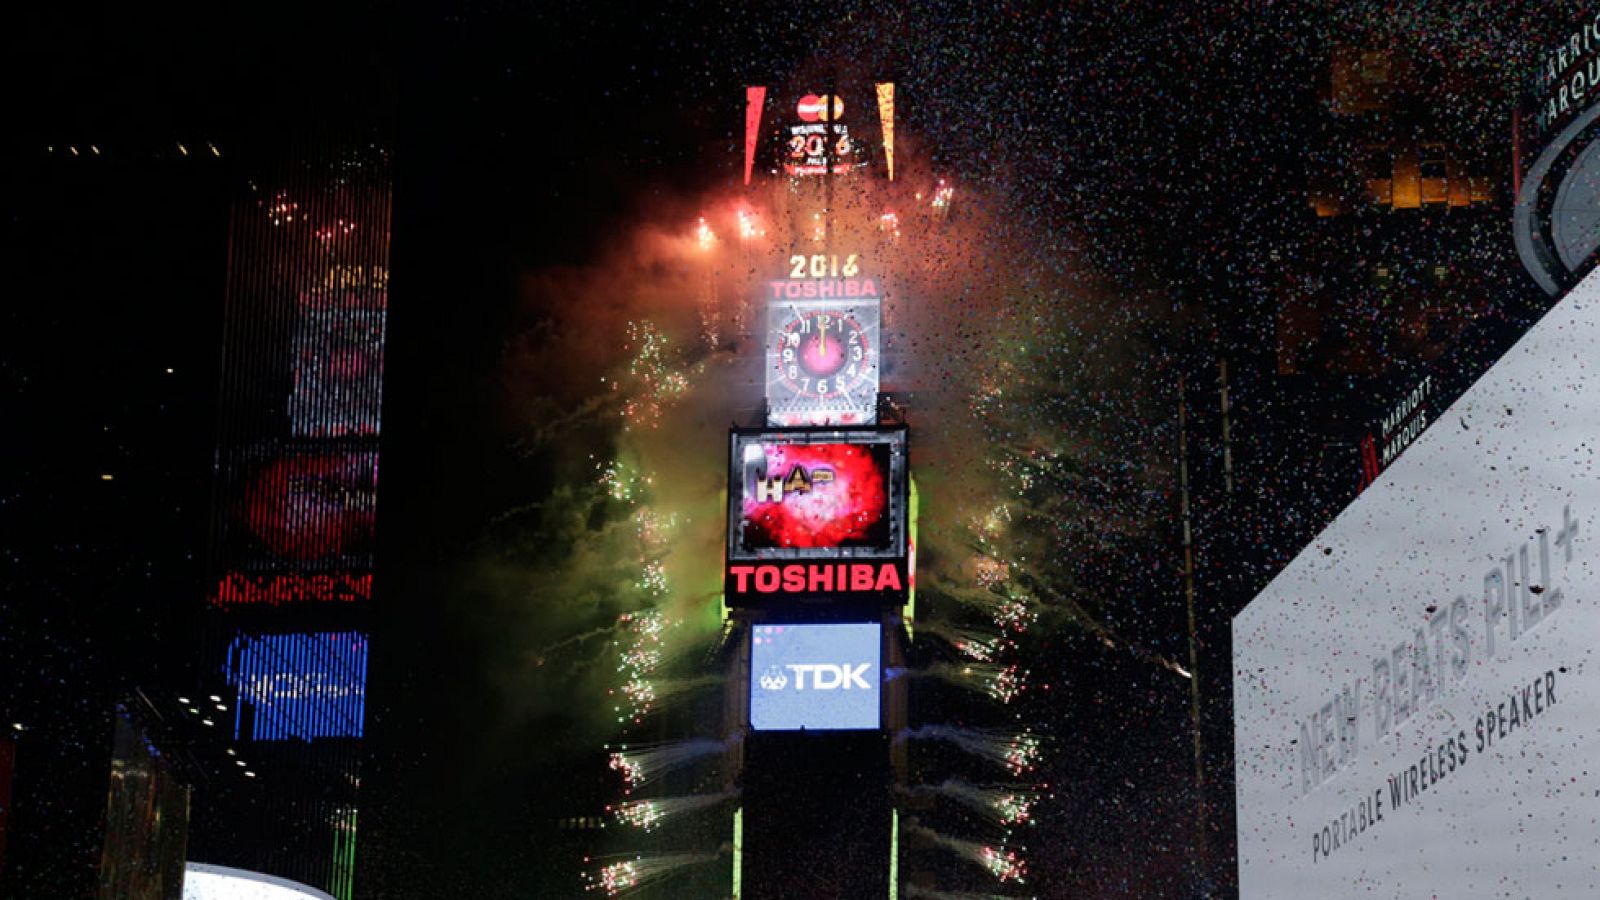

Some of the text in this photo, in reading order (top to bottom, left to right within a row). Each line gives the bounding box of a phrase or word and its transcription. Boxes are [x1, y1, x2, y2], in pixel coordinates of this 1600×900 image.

[789, 133, 850, 158] 206
[789, 254, 859, 279] 2016
[769, 281, 877, 298] TOSHIBA
[849, 331, 858, 344] 2
[783, 349, 794, 362] 9
[852, 346, 863, 361] 3
[846, 364, 856, 377] 4
[801, 379, 811, 392] 7
[817, 379, 828, 393] 6
[1382, 375, 1431, 439] MARRIOTT
[1382, 409, 1426, 465] MARQUIS
[730, 563, 902, 593] TOSHIBA
[1300, 503, 1579, 799] NEW BEATS PILL+
[785, 663, 872, 690] TDK
[1312, 670, 1557, 863] PORTABLE WIRELESS SPEAKER
